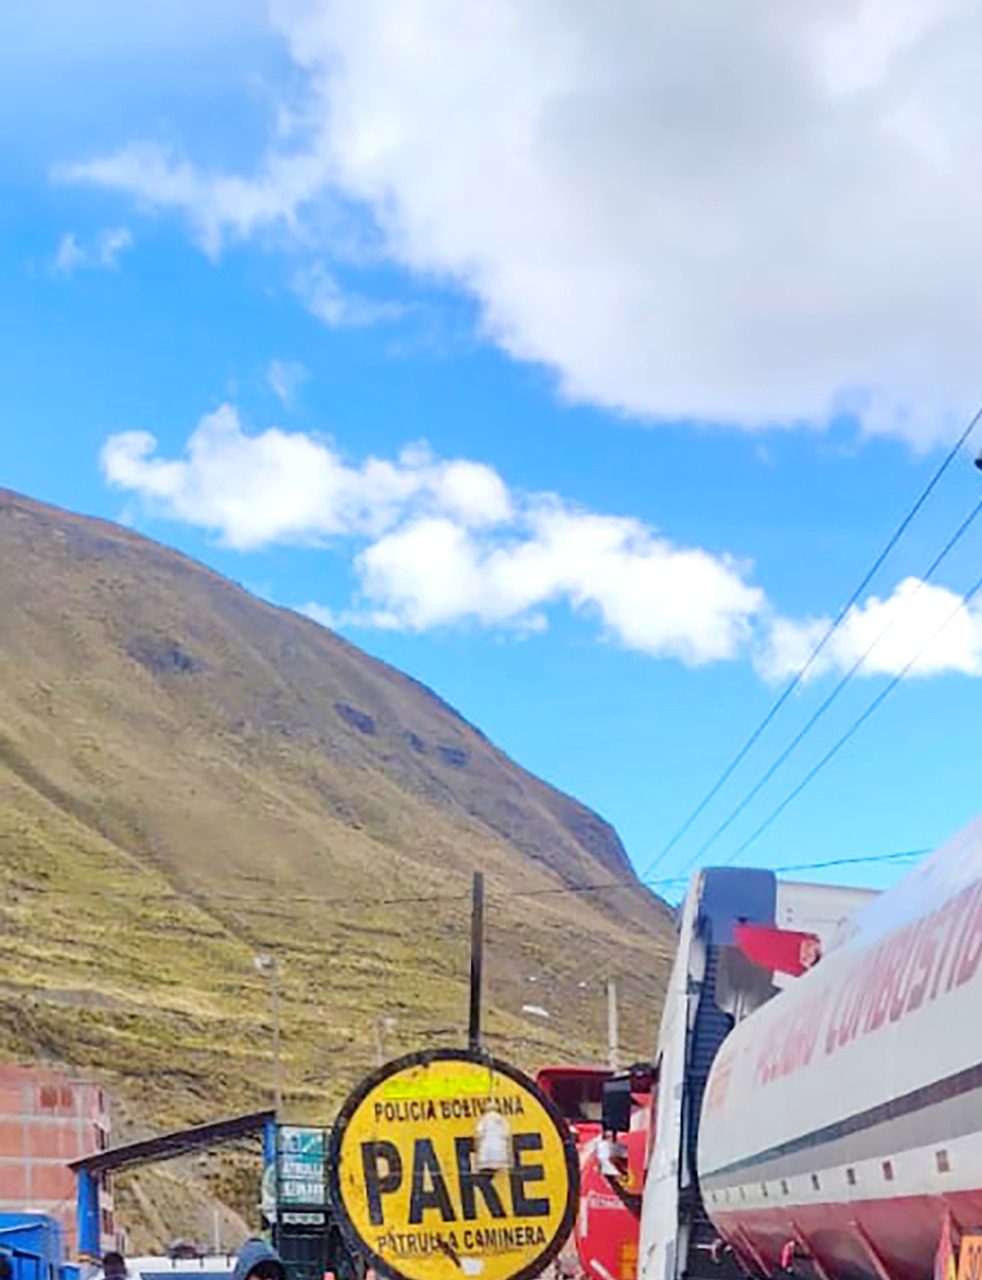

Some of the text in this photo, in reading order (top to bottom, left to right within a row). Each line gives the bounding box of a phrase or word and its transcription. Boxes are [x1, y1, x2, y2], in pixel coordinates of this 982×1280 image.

[374, 1096, 524, 1123] POLICIA BOLIVANA
[361, 1133, 550, 1226] PARE
[463, 1226, 547, 1250] CAMINERA
